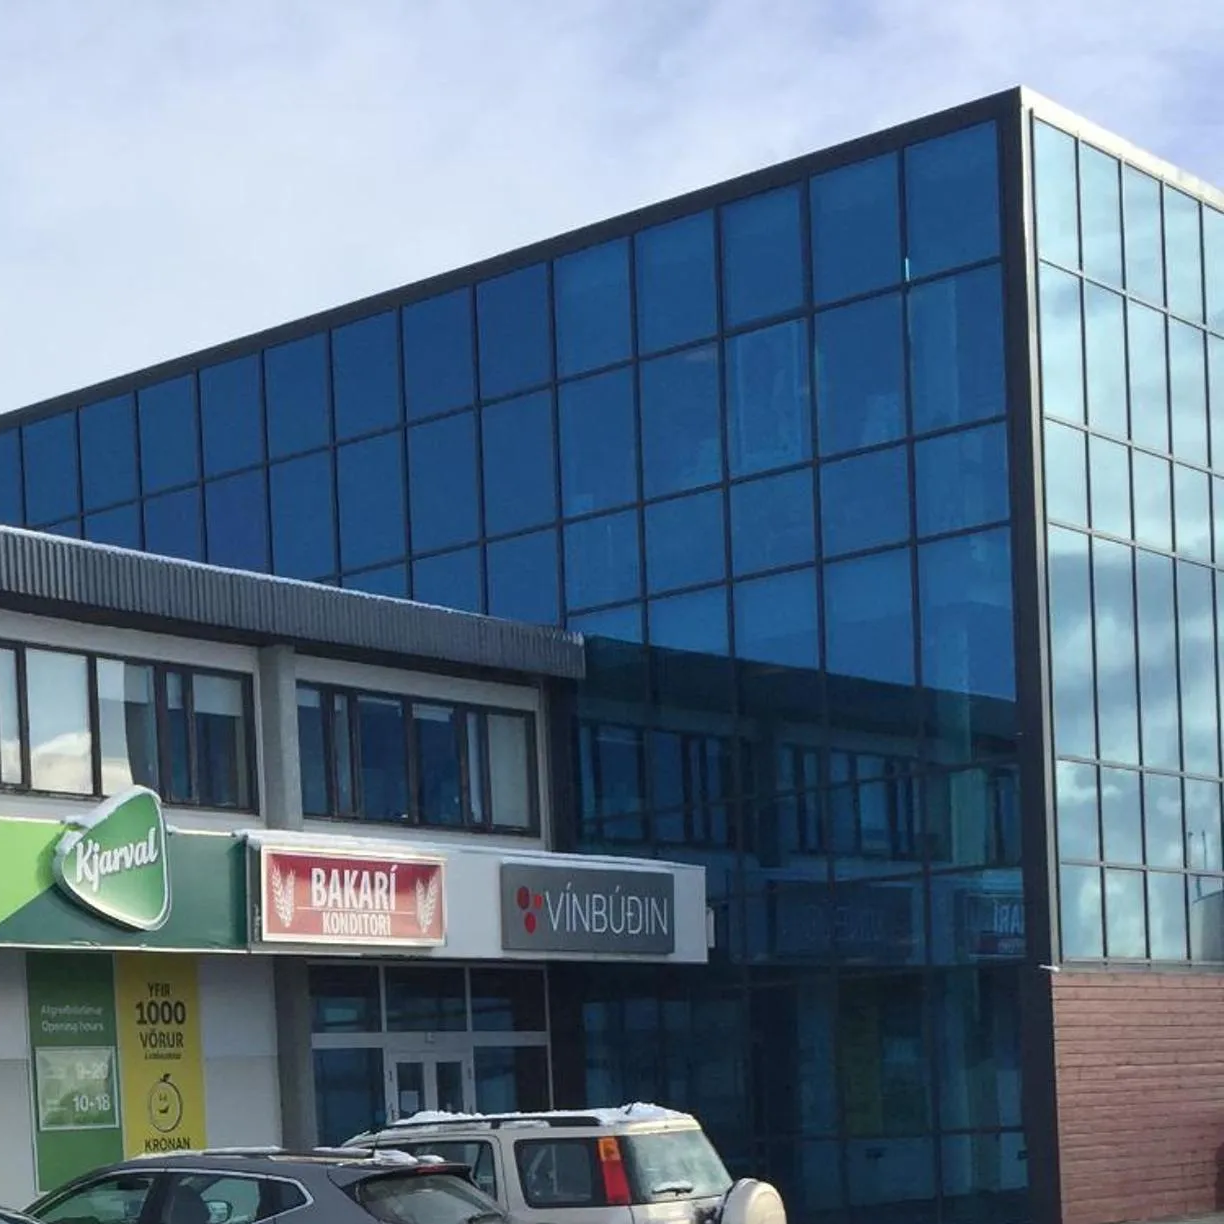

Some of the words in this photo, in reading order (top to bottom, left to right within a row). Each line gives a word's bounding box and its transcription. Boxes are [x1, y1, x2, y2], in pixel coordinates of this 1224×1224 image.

[75, 827, 158, 893] Kjarval
[311, 865, 398, 911] BAKARÍ
[545, 882, 669, 936] VÍNBÚÐIN
[322, 912, 391, 936] KONDITORI
[147, 983, 172, 998] YFIR
[135, 1001, 186, 1025] 1000
[144, 1137, 190, 1152] KRONAN
